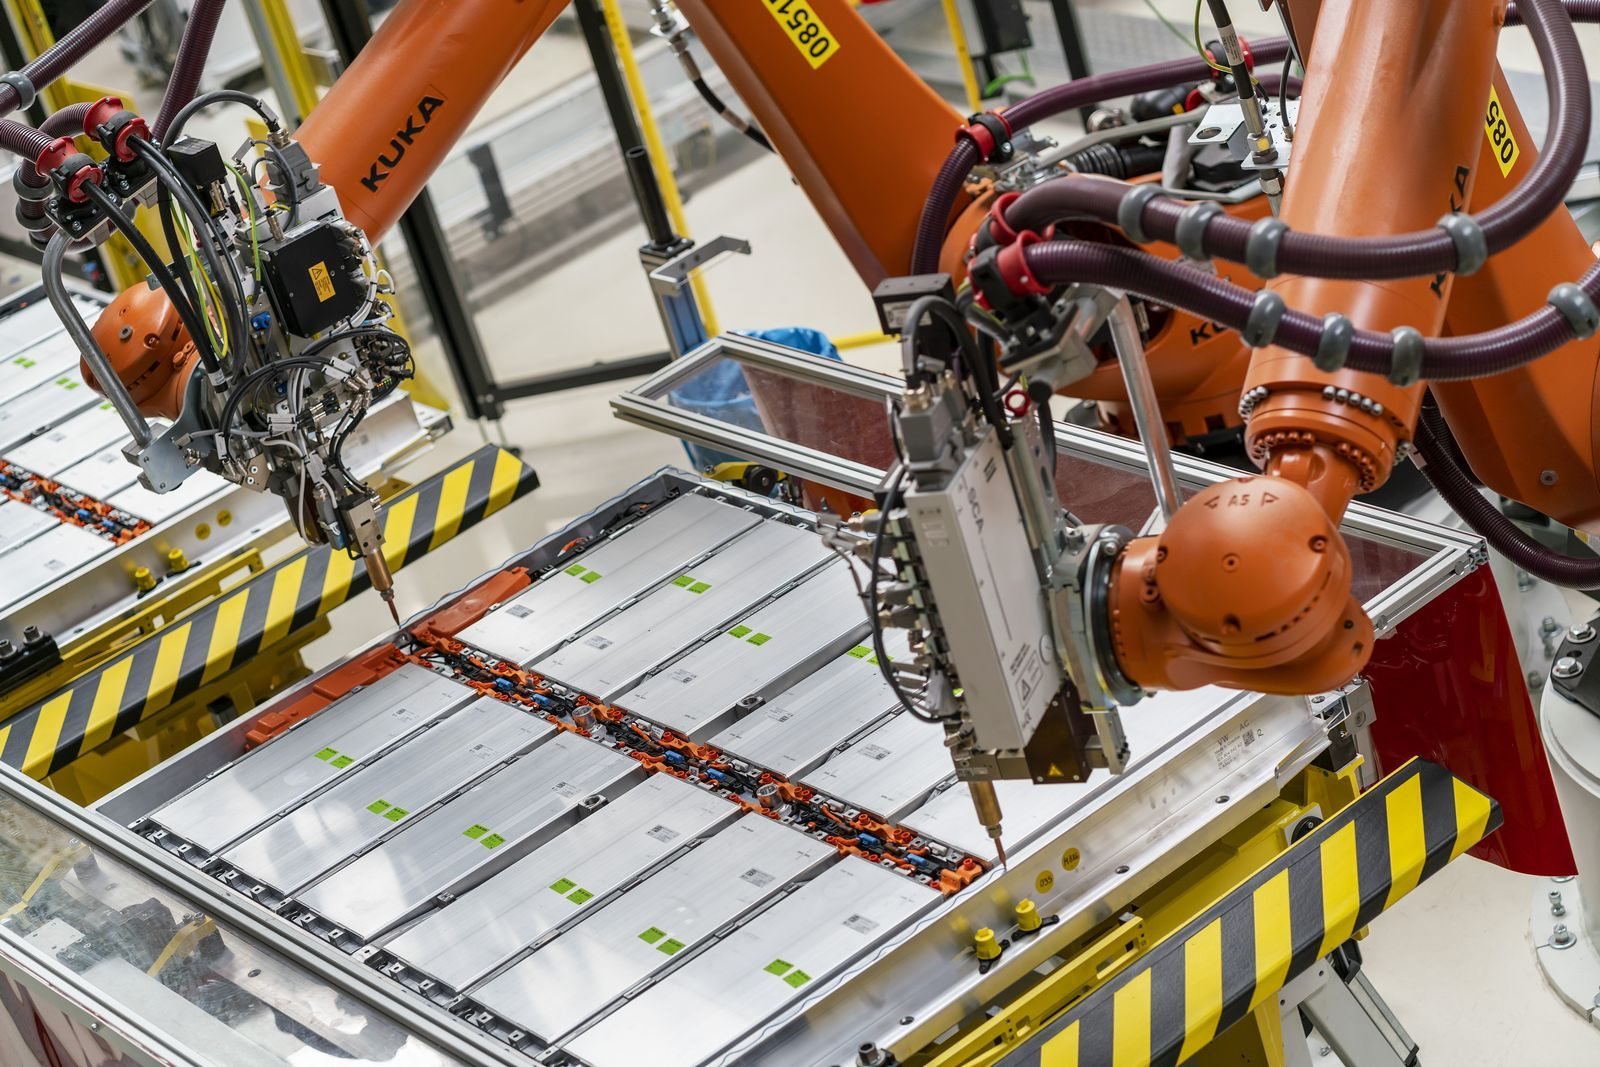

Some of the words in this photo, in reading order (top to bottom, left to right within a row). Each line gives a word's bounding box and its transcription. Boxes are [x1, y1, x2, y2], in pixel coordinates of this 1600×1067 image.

[768, 0, 829, 58] 0851
[361, 96, 444, 192] KUKA
[1228, 494, 1251, 507] A5
